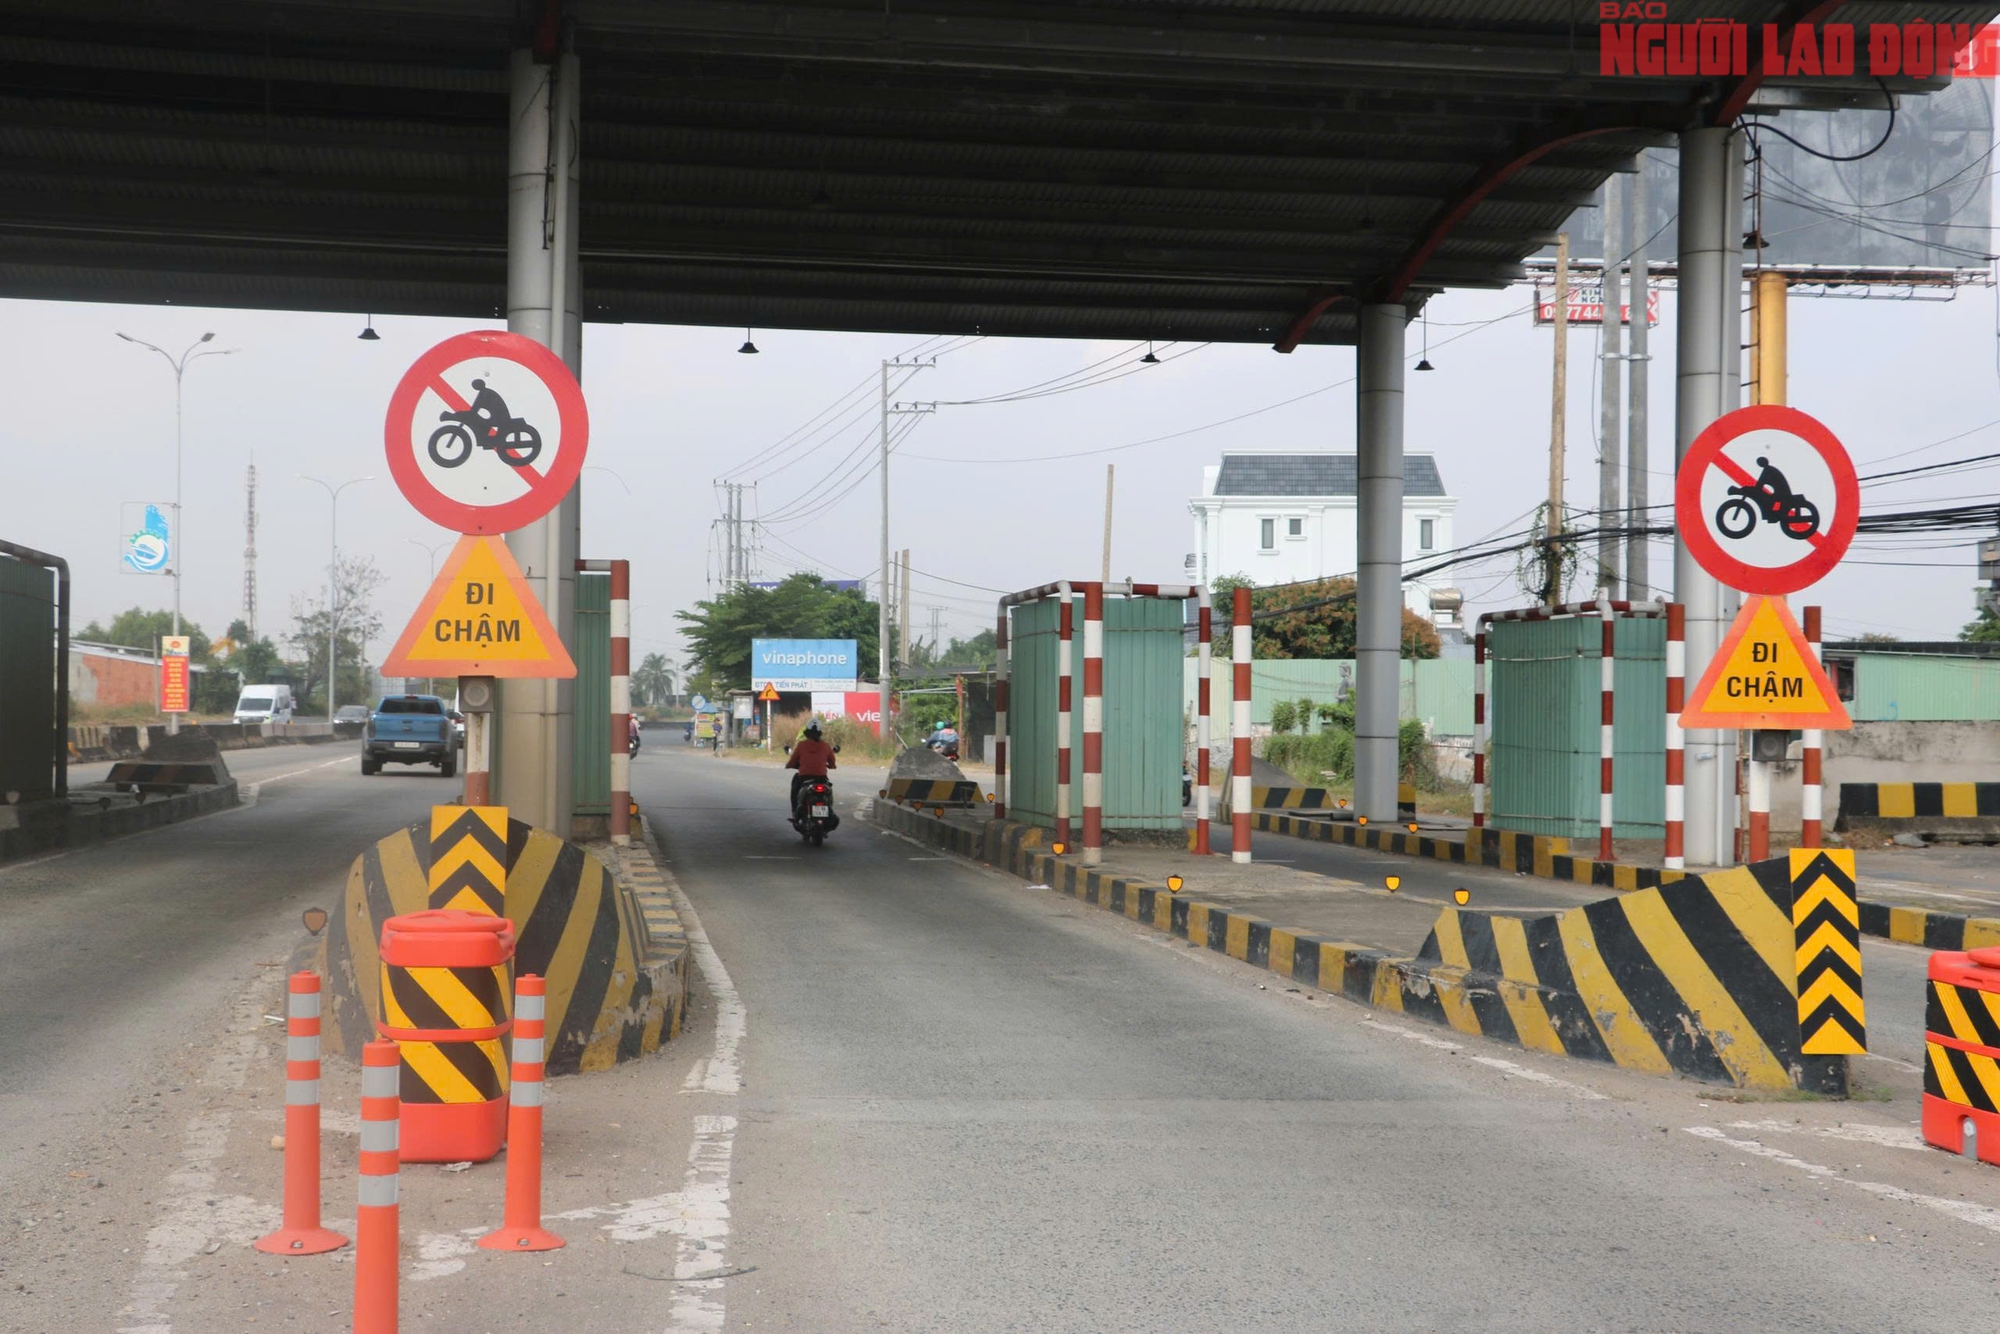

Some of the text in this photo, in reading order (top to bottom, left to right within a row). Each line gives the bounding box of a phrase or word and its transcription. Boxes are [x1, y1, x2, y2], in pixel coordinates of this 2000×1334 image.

[466, 582, 493, 605] ĐI
[435, 613, 520, 648] CHẬM
[762, 650, 847, 667] vinaphone
[1752, 642, 1777, 663] ĐI
[1727, 670, 1803, 703] CHẬM
